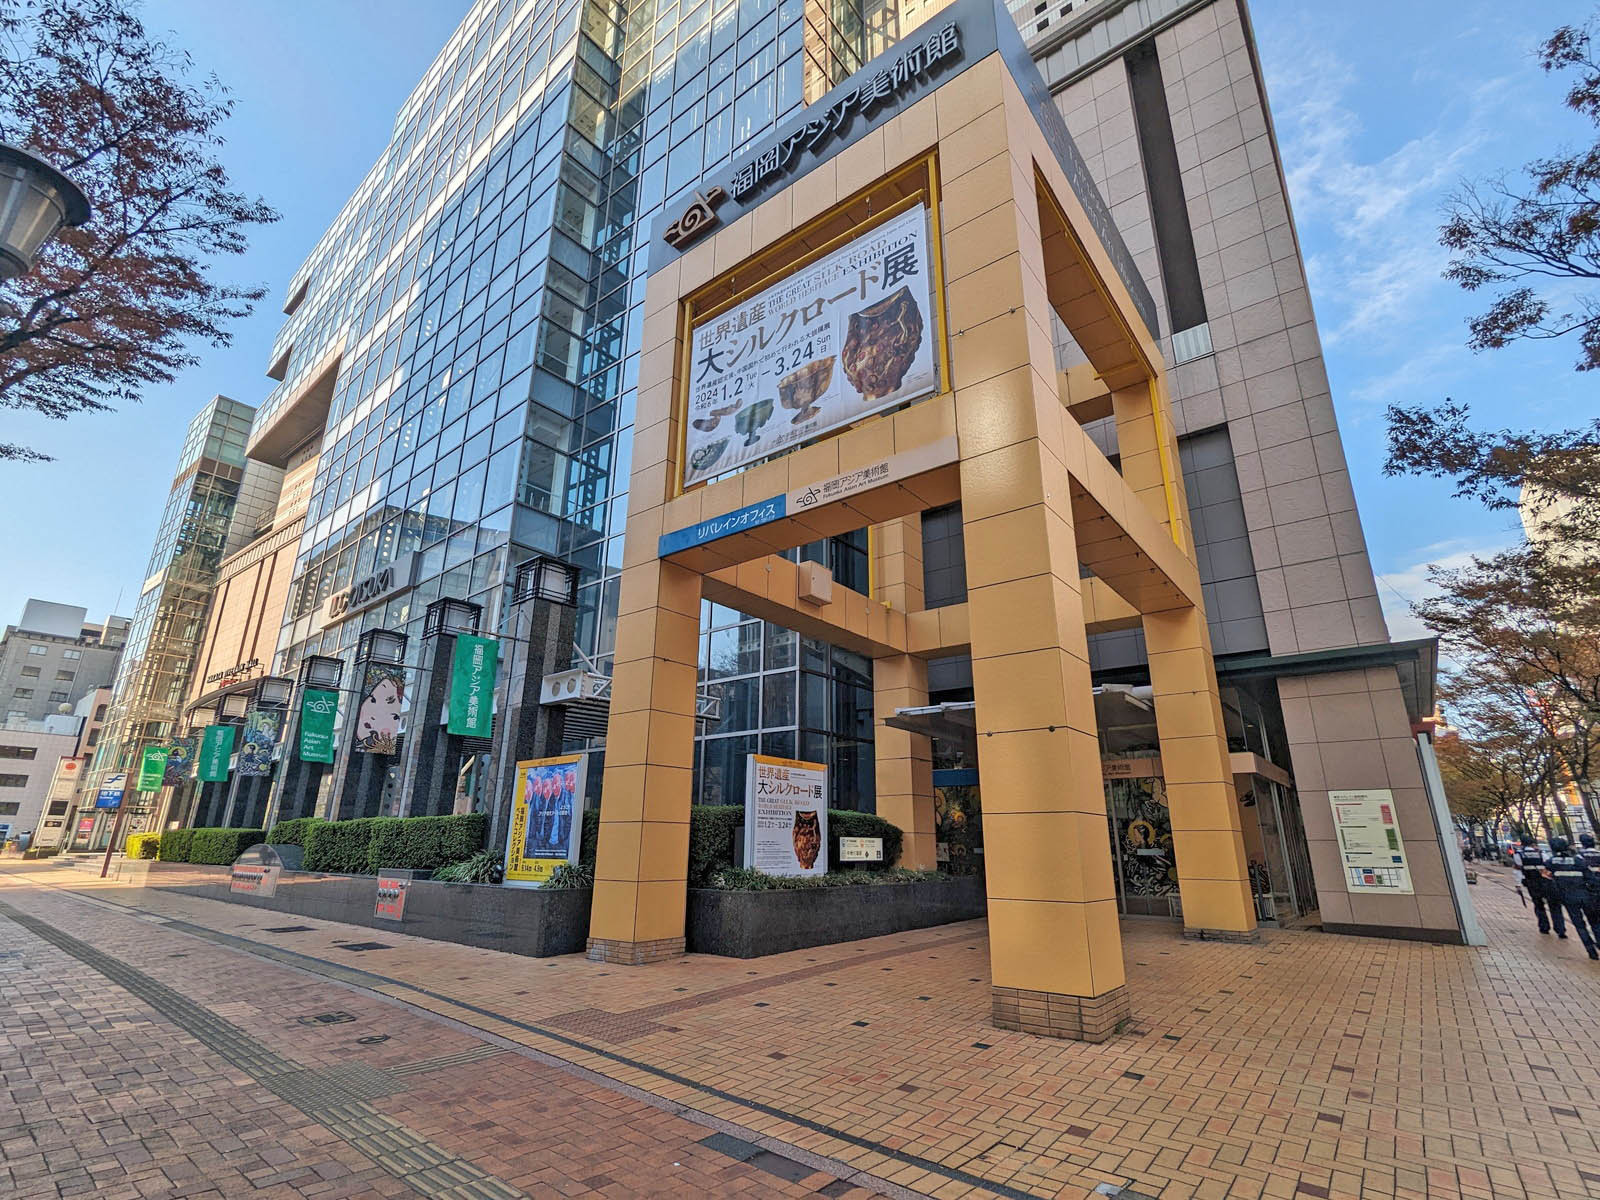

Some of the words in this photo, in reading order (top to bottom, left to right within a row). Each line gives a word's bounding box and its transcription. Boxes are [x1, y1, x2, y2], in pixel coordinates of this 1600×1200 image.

[730, 21, 959, 198] 福岡アジア美術館
[768, 297, 796, 315] WORLD
[842, 230, 918, 276] EXHIBITION
[768, 294, 784, 308] THE
[785, 280, 811, 299] GREAT
[848, 240, 887, 264] ROAD
[696, 242, 919, 383] 大シルクロード展
[700, 301, 766, 351] 世界遺産
[695, 388, 718, 404] 2024
[722, 377, 743, 400] 1.2
[746, 371, 758, 381] Tue
[774, 341, 815, 376] 3.24
[817, 335, 831, 347] Sun
[823, 463, 889, 493] 福岡アジア美術館
[698, 504, 776, 539] リバレインオフィス
[466, 644, 484, 728] 福岡アジア美術館
[758, 766, 790, 780] 世界遺産
[758, 780, 822, 799] 大シルクロード展
